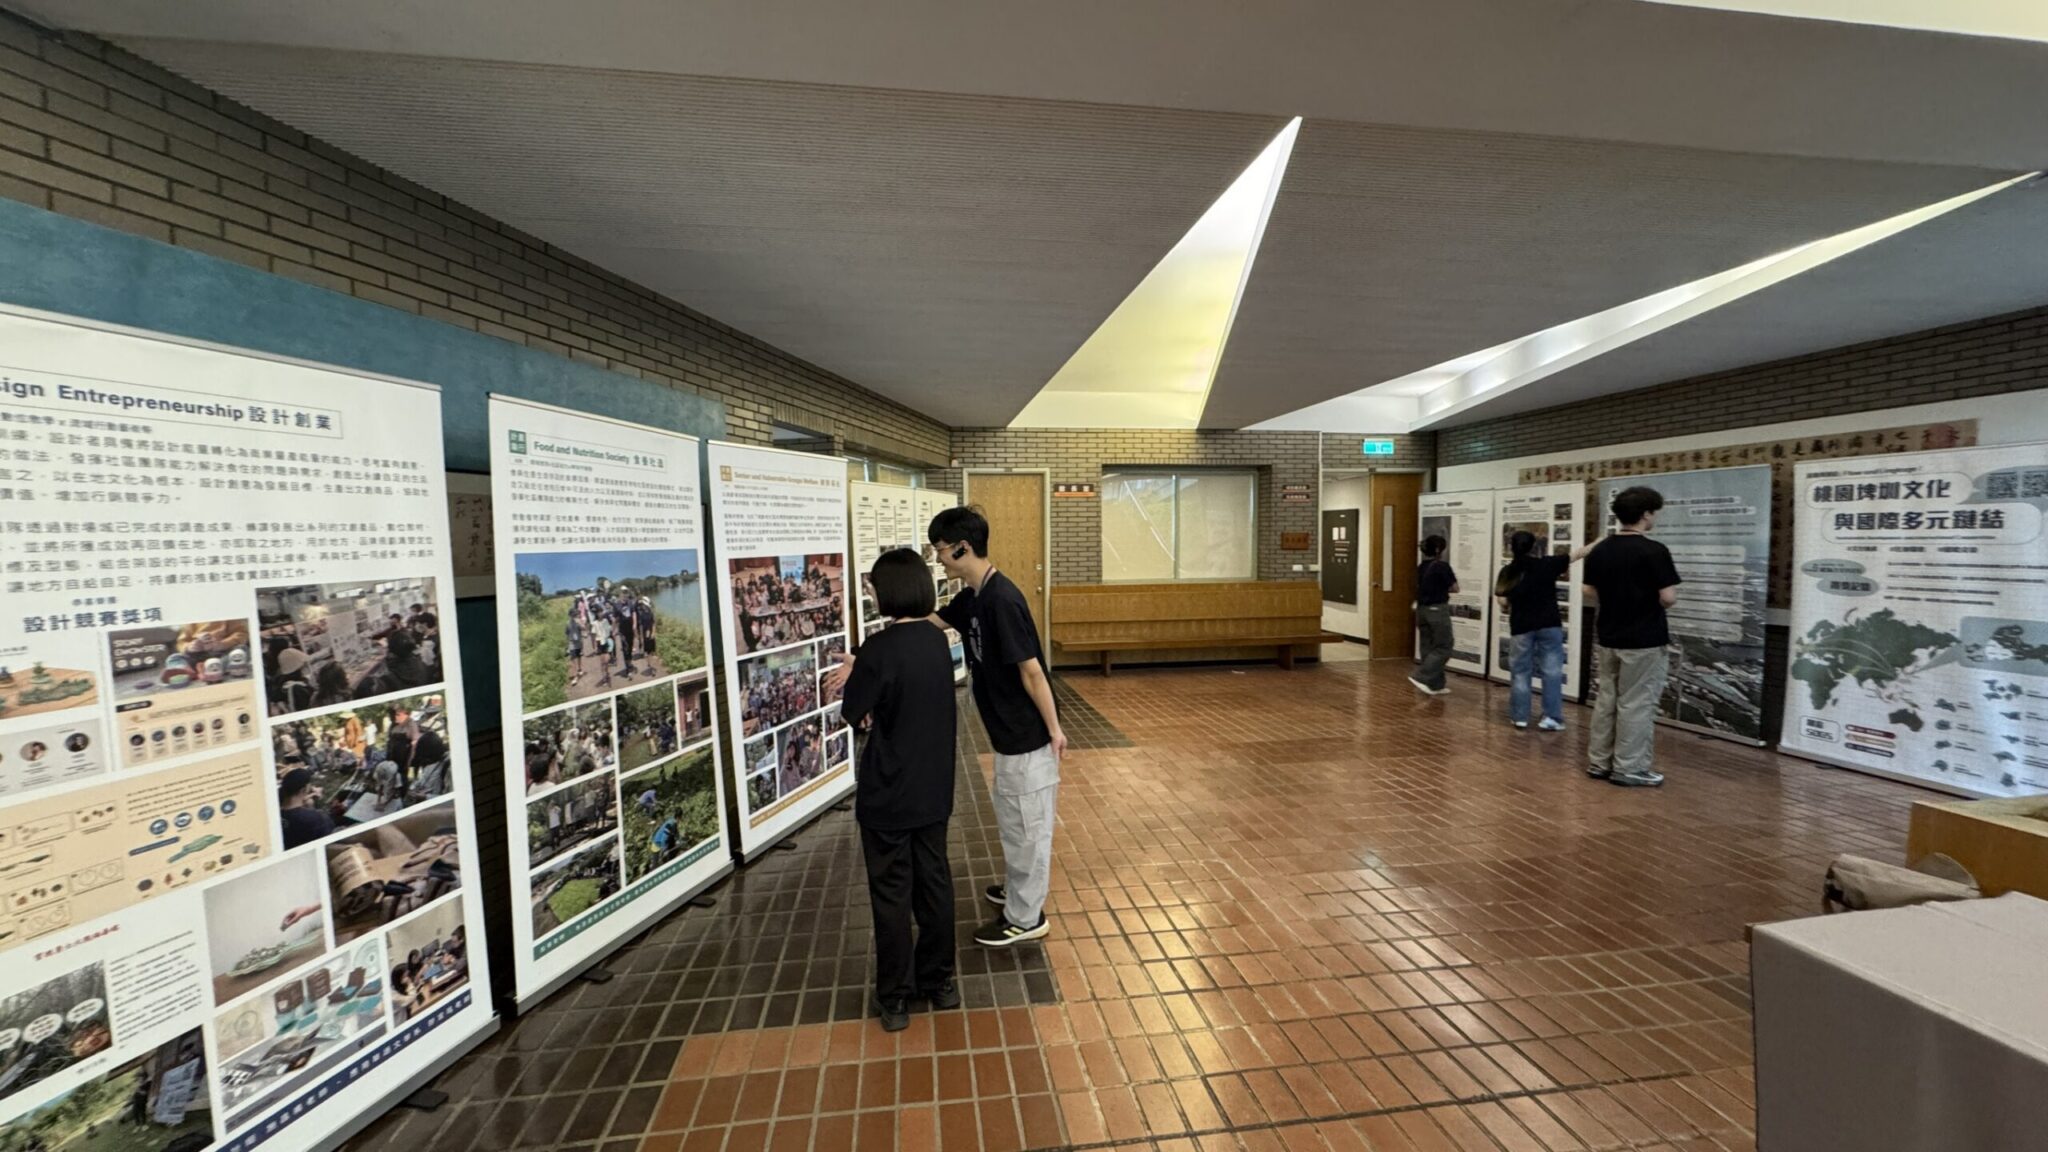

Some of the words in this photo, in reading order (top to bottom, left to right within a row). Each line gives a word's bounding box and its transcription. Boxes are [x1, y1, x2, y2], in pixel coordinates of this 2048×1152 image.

[58, 384, 245, 421] Entrepreneurship
[249, 405, 333, 431] 設計創業
[534, 441, 555, 453] Food
[556, 445, 570, 456] and
[572, 447, 604, 459] Nutrition
[606, 451, 630, 465] Society
[1813, 479, 1952, 503] 桃園埤圳文化
[1834, 508, 2005, 531] 與國際多元鏈結
[23, 607, 163, 633] 設計競賽獎項
